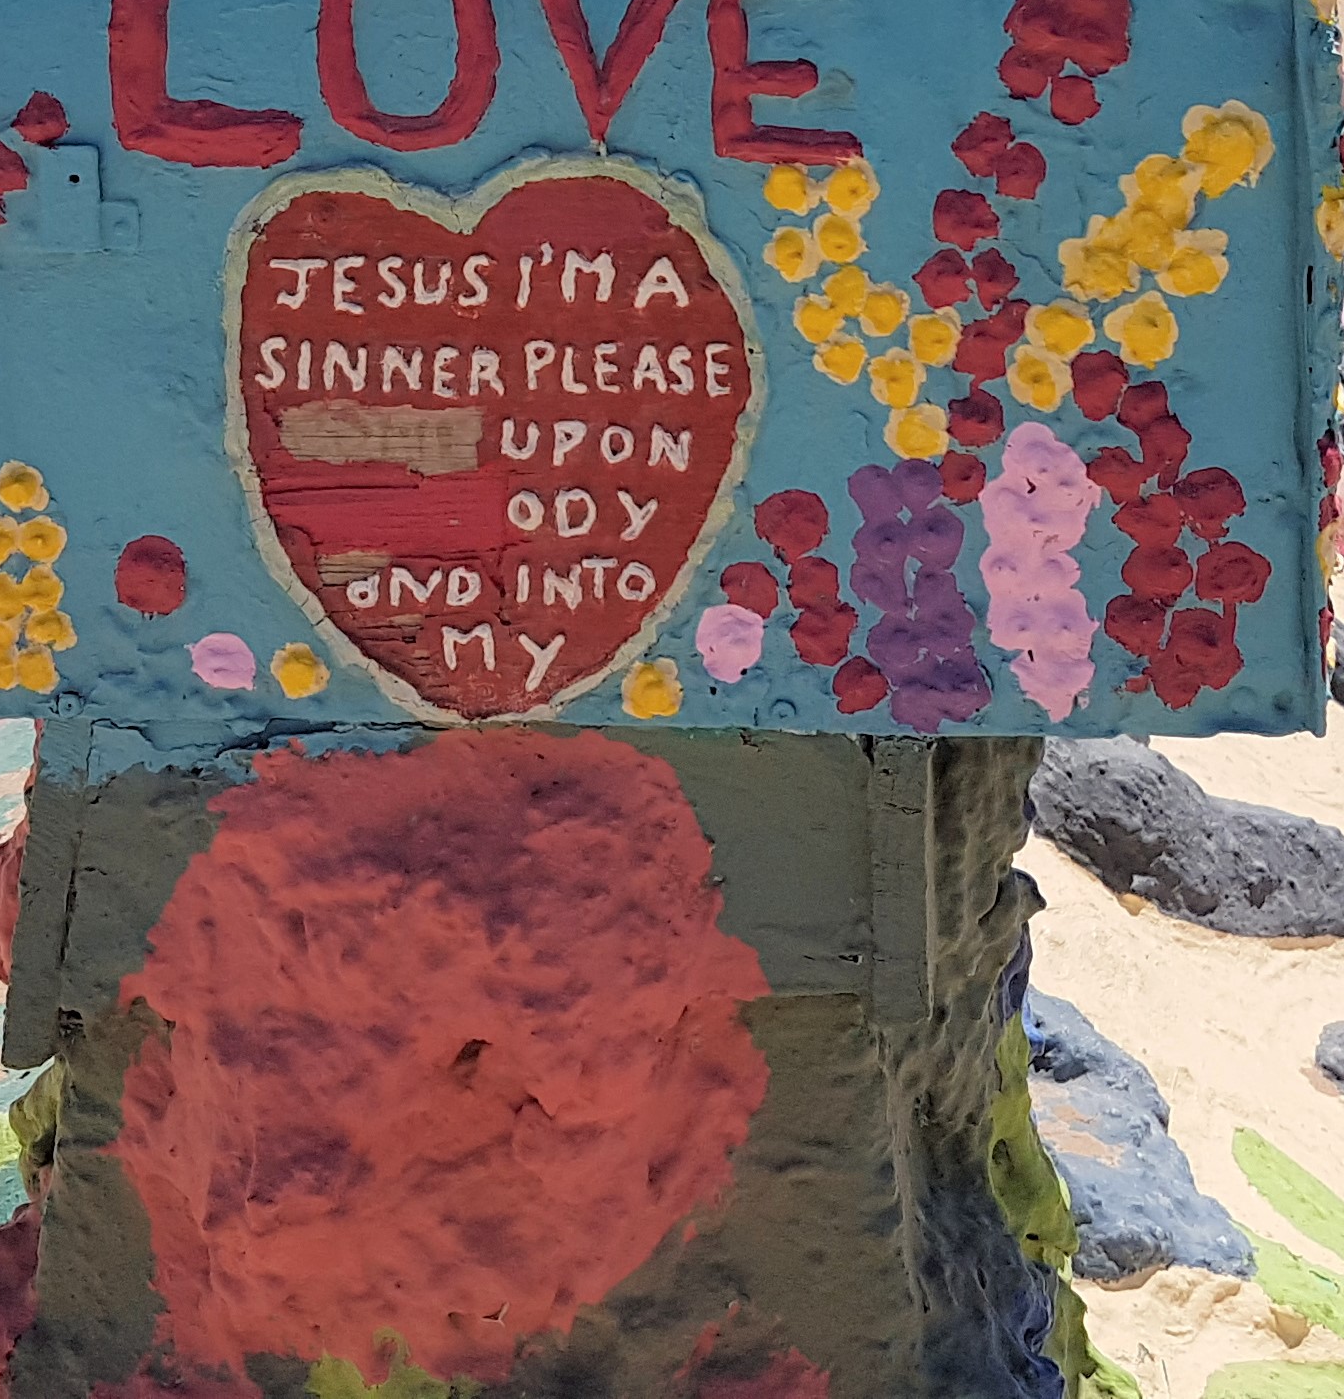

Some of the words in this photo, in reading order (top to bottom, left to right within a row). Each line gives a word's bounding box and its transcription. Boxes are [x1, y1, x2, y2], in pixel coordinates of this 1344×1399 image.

[269, 254, 497, 314] JESUS
[518, 242, 616, 309] I'M
[632, 256, 691, 307] A
[255, 336, 505, 398] SINNER
[524, 340, 733, 397] PLEASE
[500, 418, 692, 471] UPON
[508, 489, 658, 540] ODY
[515, 558, 656, 610] INTO
[441, 622, 566, 692] MY
